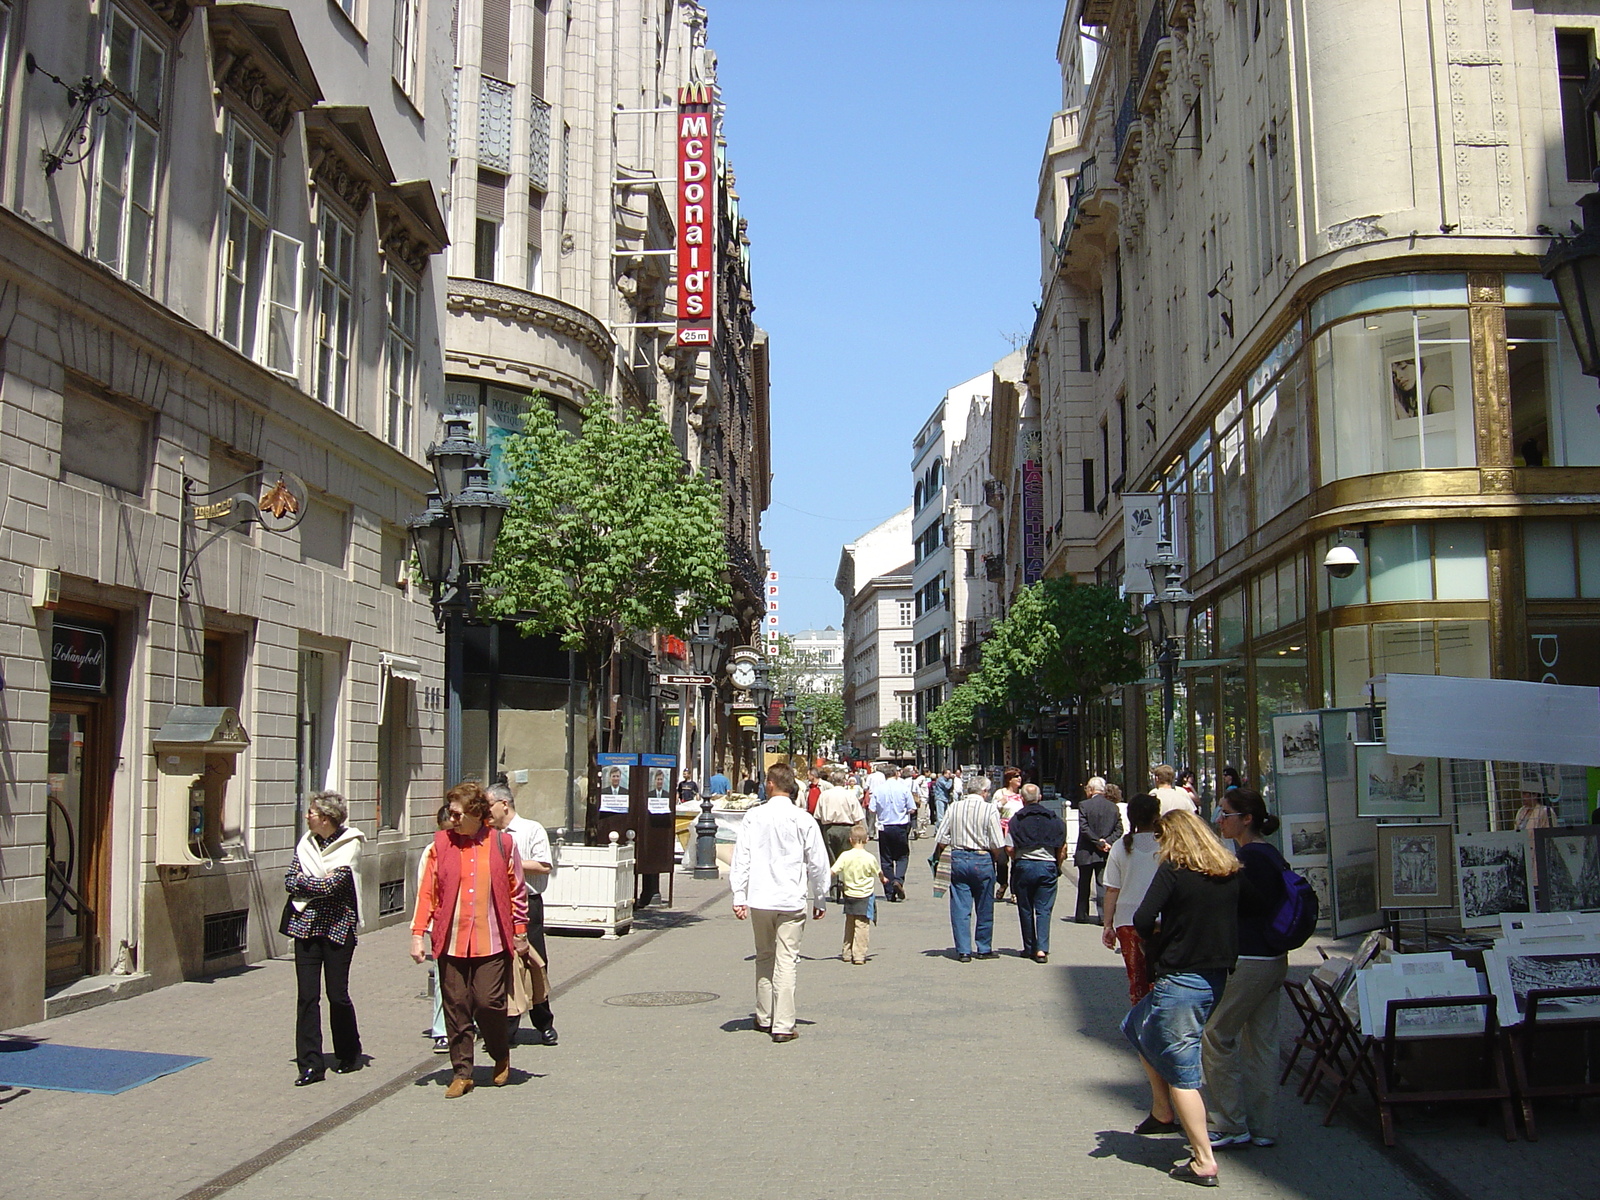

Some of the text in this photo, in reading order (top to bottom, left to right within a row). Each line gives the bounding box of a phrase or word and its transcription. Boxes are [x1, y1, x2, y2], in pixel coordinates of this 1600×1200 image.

[681, 116, 709, 314] McDonald's
[448, 407, 475, 417] SOP
[193, 497, 233, 516] TOBACCO
